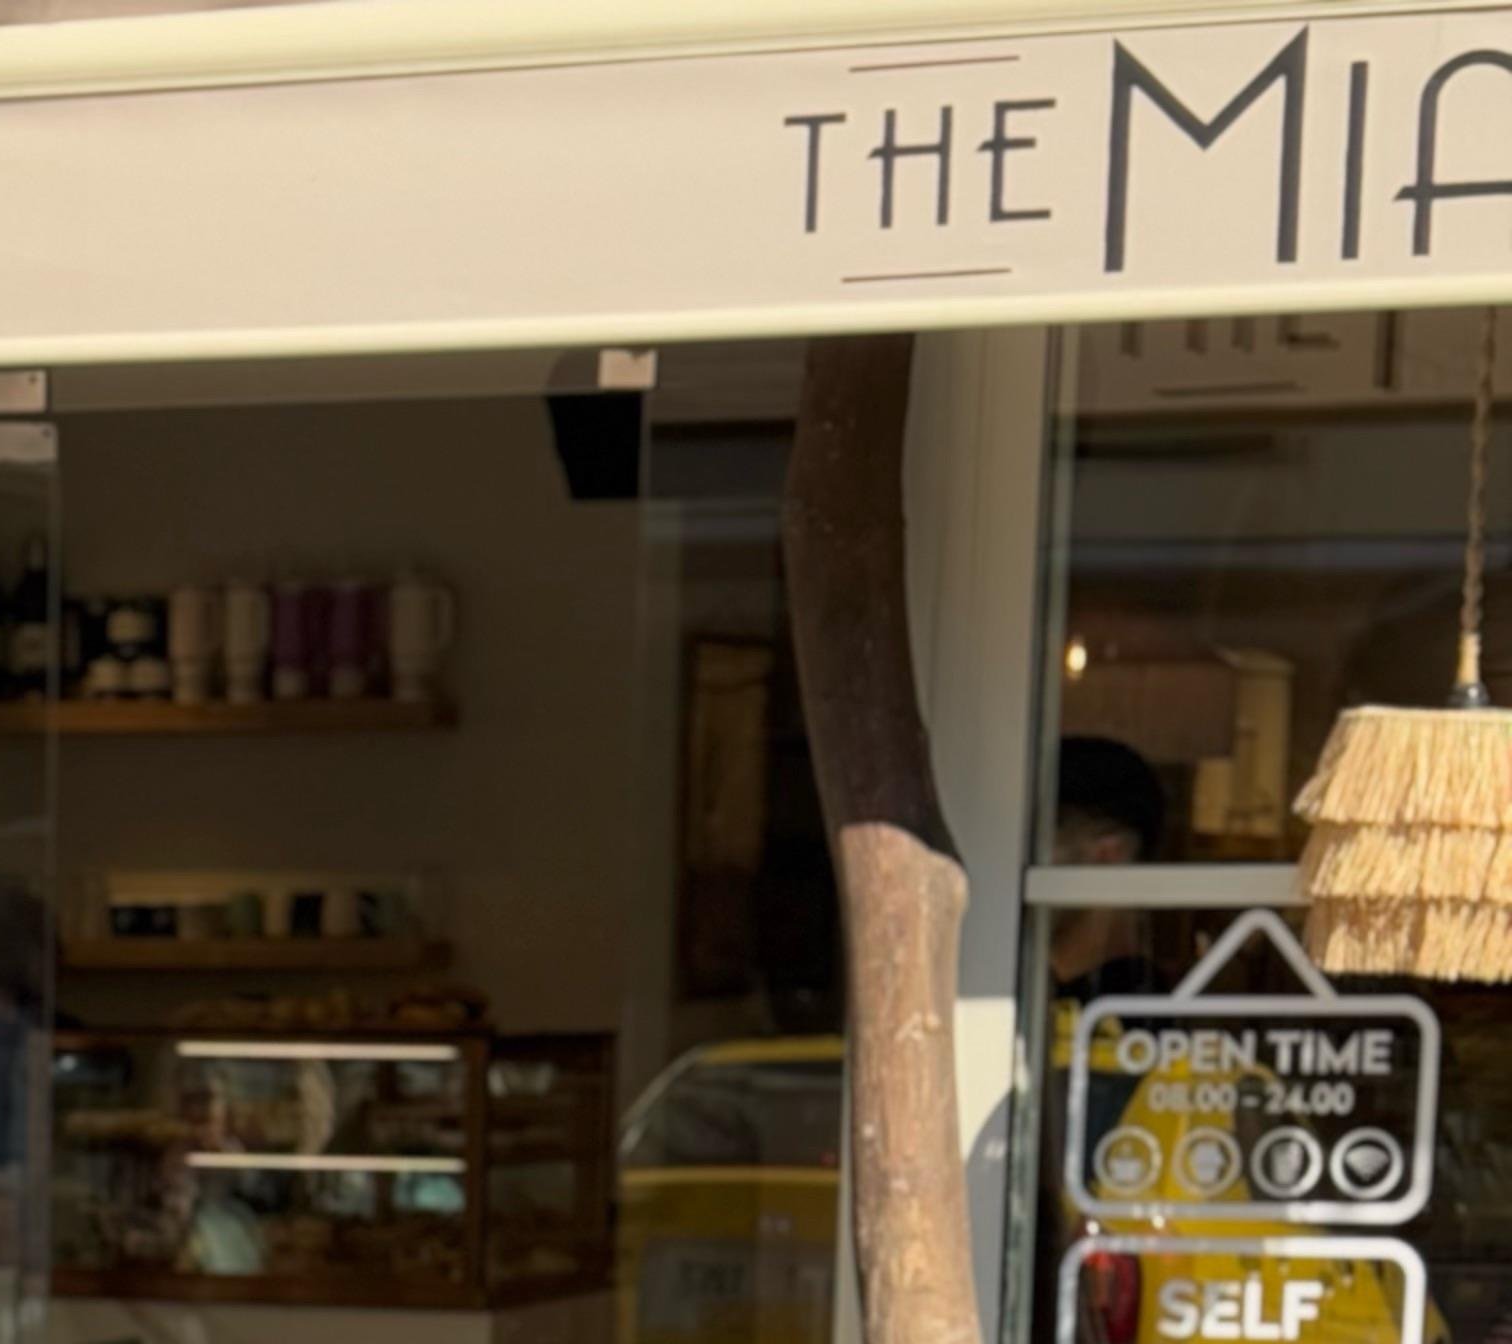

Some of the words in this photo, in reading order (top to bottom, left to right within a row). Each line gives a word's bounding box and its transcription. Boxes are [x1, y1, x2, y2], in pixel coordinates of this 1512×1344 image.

[784, 98, 1057, 234] THE
[1116, 1029, 1257, 1075] OPEN
[1266, 1029, 1394, 1077] TIME
[1148, 1081, 1237, 1113] 08.00
[1264, 1081, 1356, 1116] 24.00
[1156, 1277, 1324, 1341] SELF
